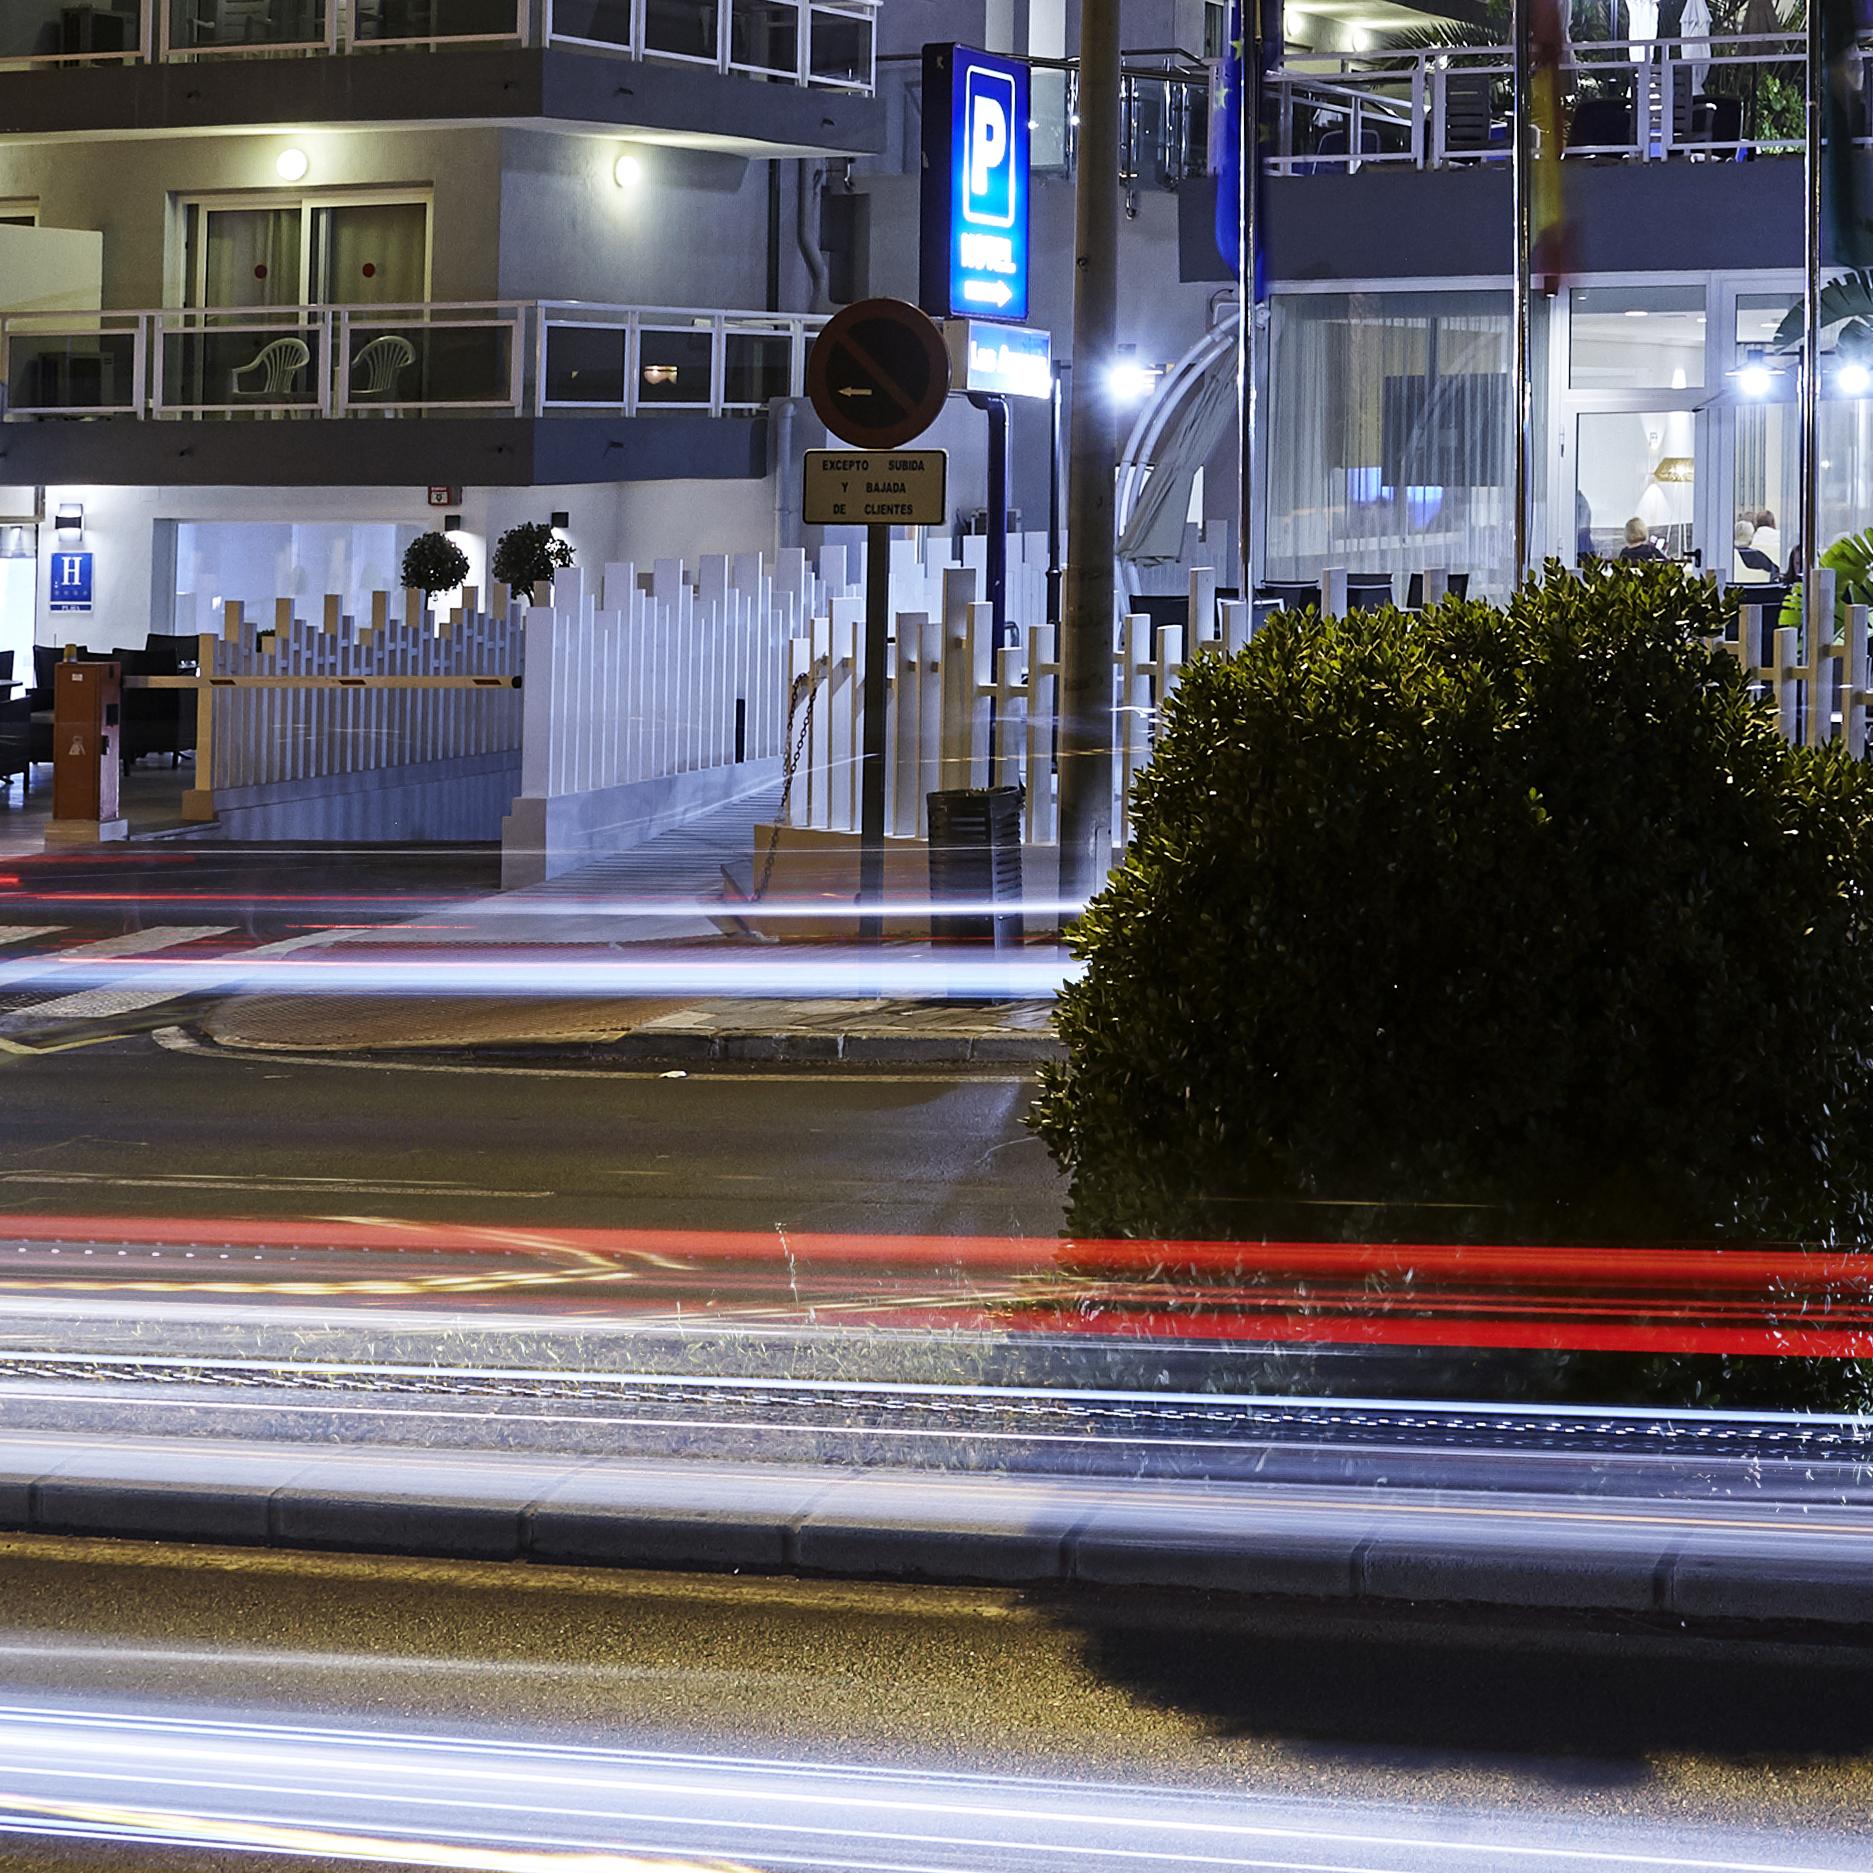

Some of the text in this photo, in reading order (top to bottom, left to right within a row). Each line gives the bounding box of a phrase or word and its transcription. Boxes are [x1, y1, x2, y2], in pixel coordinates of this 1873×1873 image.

[970, 95, 1007, 196] P
[822, 459, 925, 471] EXCEPTO SUBIDA
[841, 482, 906, 493] Y BAJADA
[833, 504, 913, 515] DE CLIENTES
[61, 556, 82, 585] H
